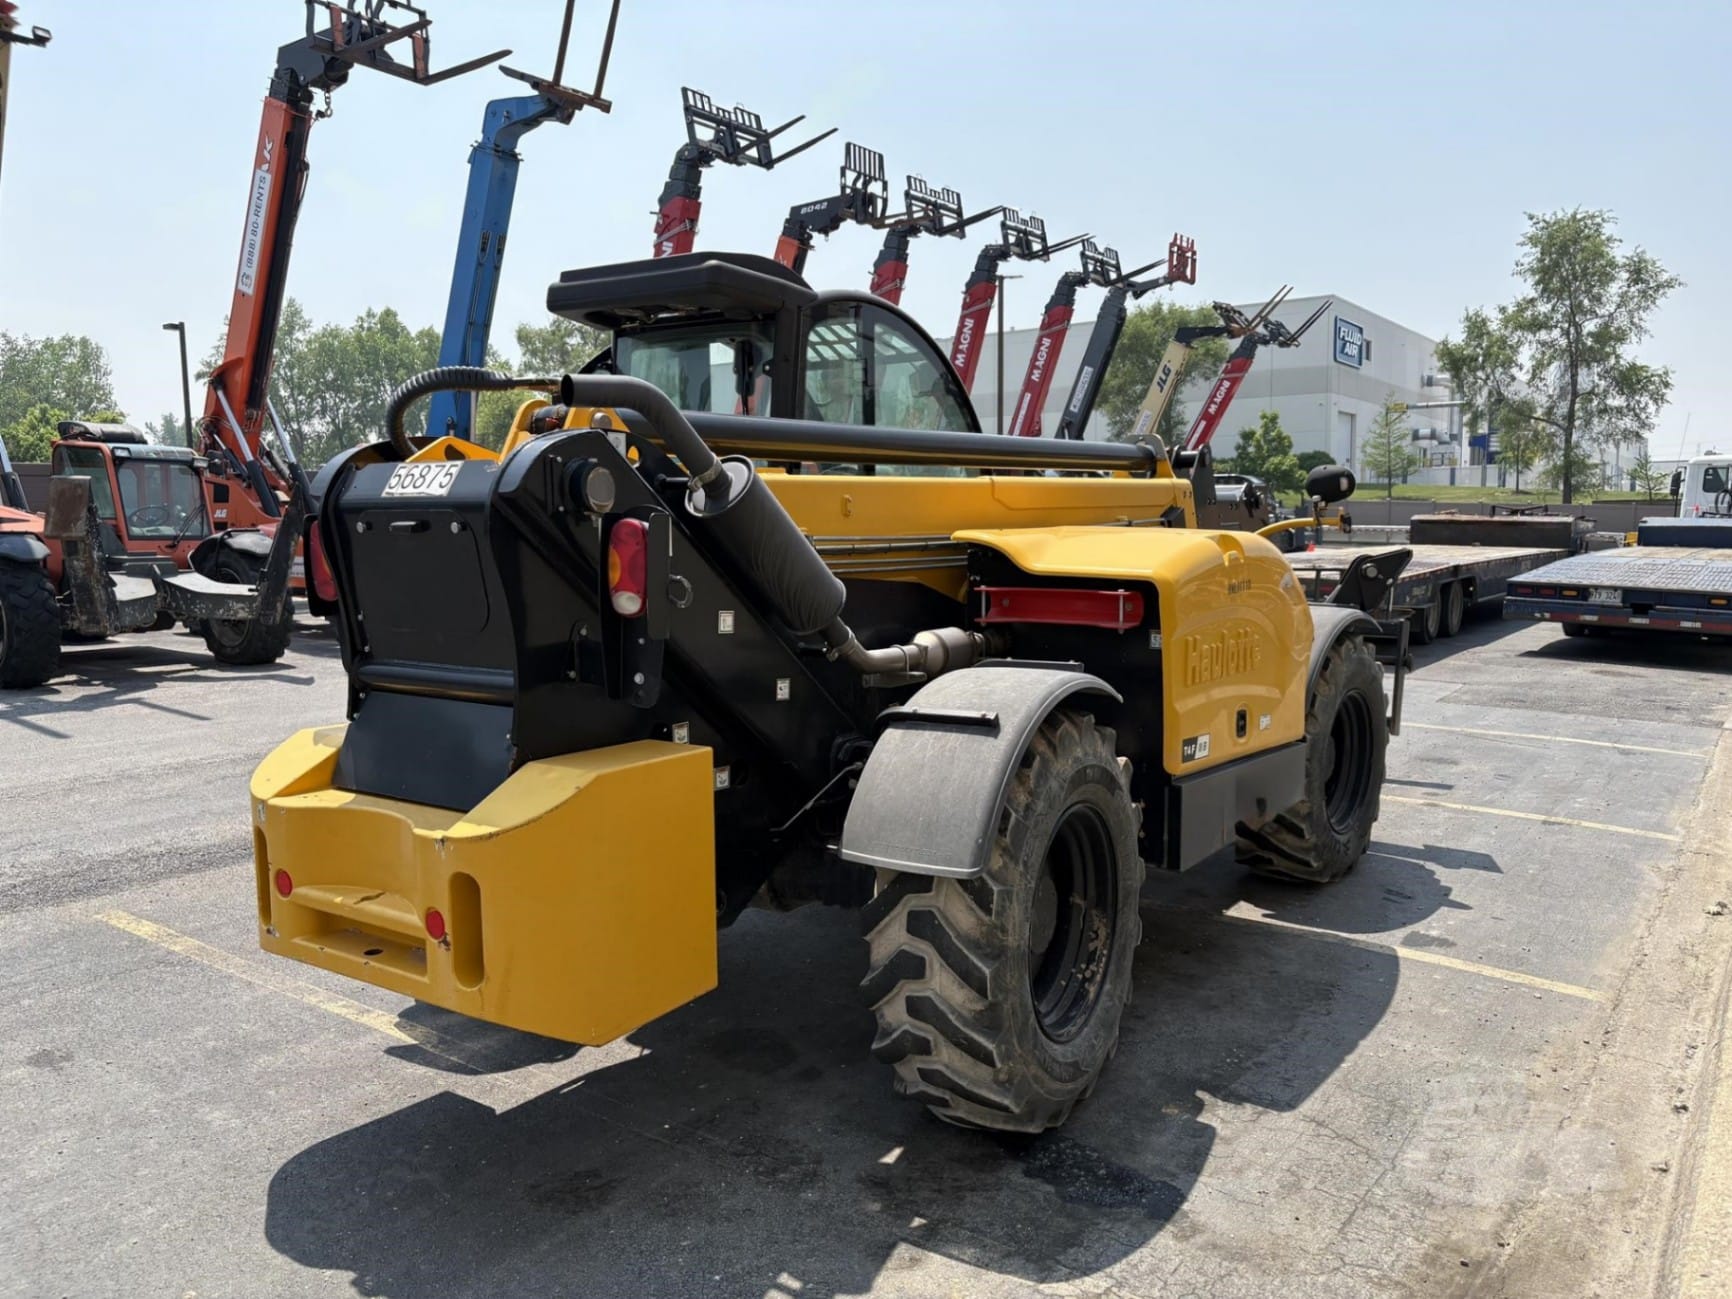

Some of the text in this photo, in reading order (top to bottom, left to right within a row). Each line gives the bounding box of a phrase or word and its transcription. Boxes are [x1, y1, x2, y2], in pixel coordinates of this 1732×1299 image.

[954, 318, 974, 367] MAGNI
[1340, 327, 1362, 346] FLUID
[1344, 342, 1358, 357] AIR
[1031, 337, 1051, 382] MAGNI
[1156, 363, 1172, 394] JLG
[1207, 380, 1231, 415] MAGNI
[388, 464, 459, 489] 56875
[1184, 627, 1260, 688] Haulotte
